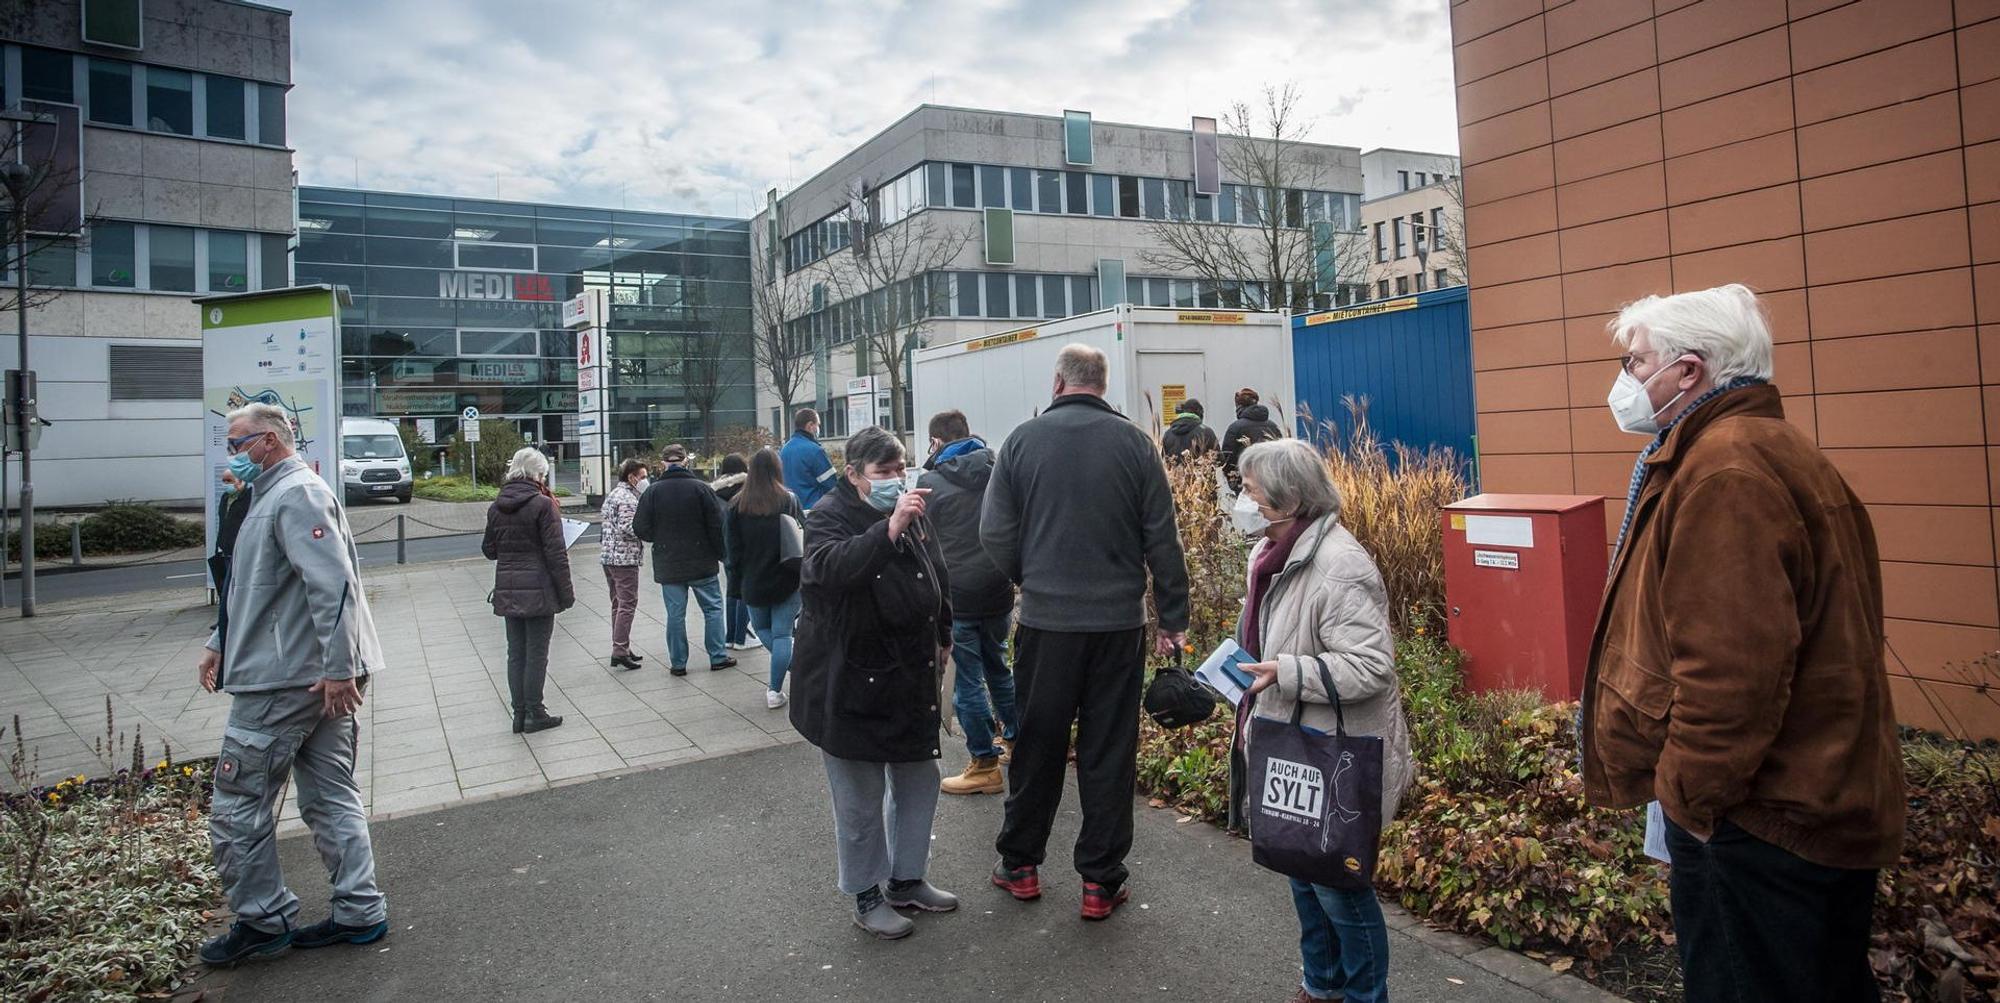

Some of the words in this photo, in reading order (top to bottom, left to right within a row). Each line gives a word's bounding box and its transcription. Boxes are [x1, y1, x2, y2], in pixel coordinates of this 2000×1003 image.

[439, 272, 513, 300] MEDI
[1332, 303, 1387, 321] MIETCONTAINER
[471, 362, 507, 377] MEDI
[1270, 762, 1298, 778] AUCH
[1301, 769, 1320, 783] AUF
[1267, 777, 1320, 813] SYLT
